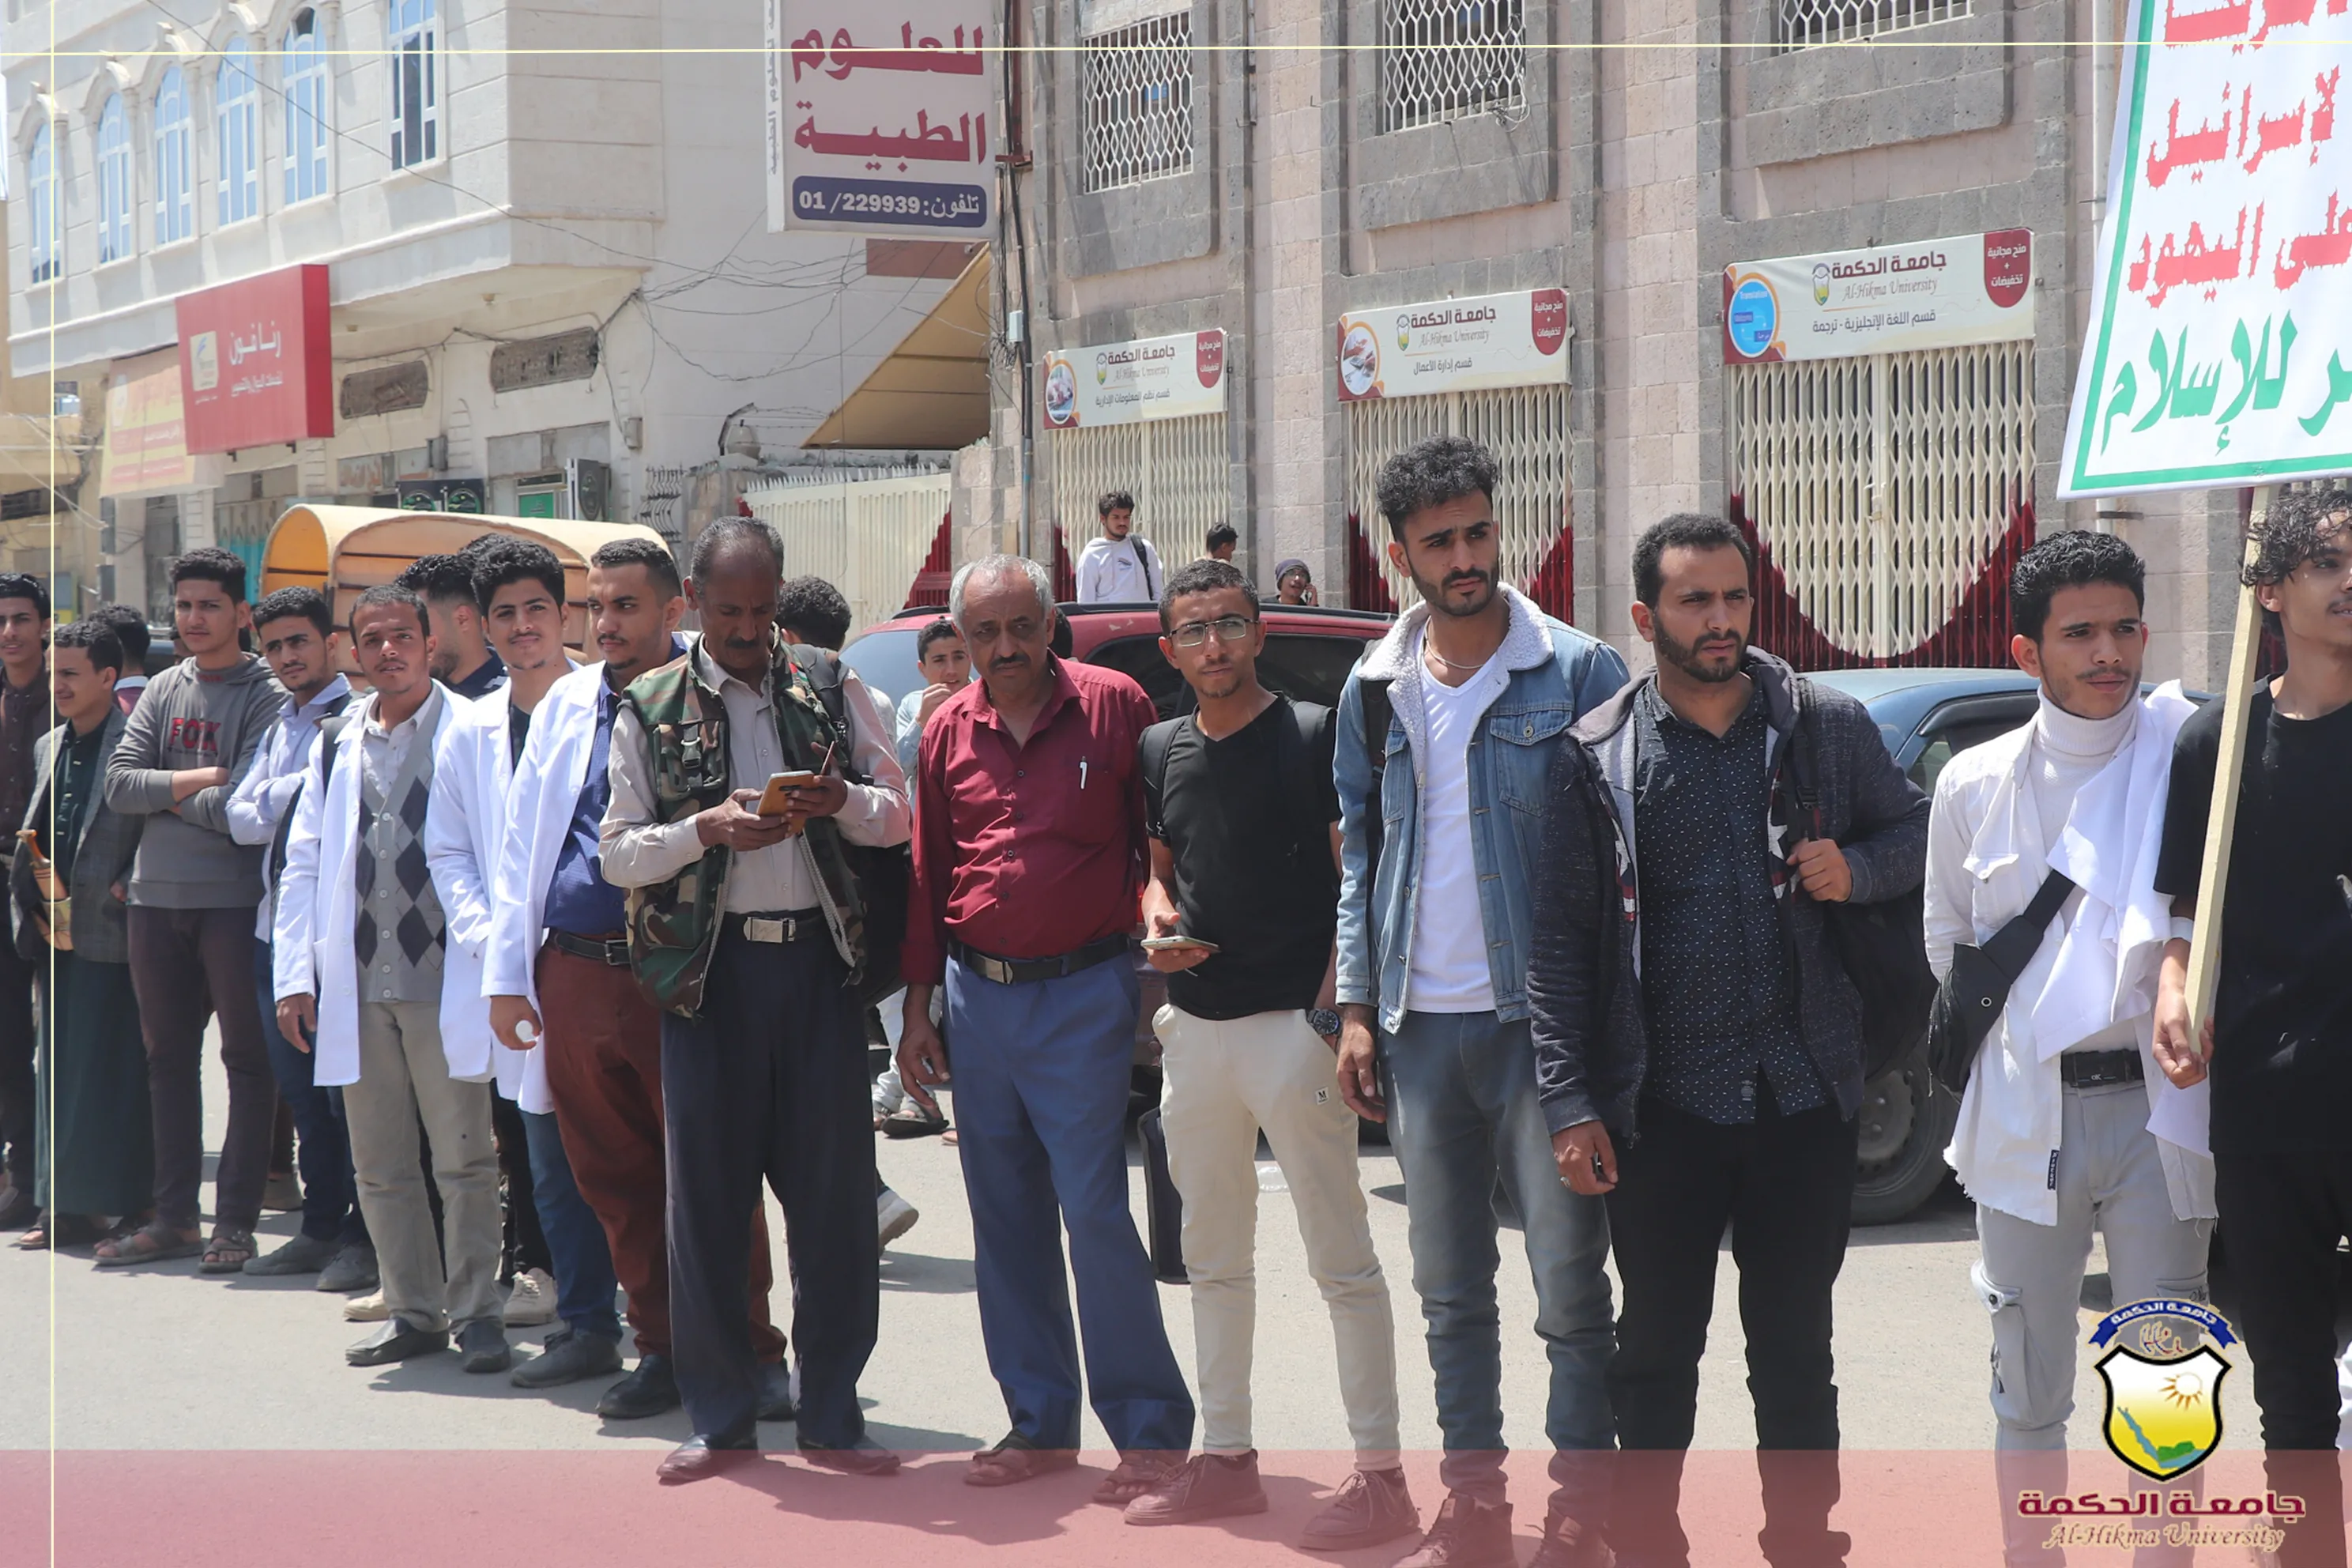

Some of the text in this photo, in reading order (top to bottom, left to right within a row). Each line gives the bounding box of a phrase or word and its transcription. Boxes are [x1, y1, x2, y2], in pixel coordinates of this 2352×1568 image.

[791, 21, 984, 84] للعلوم
[794, 100, 986, 173] الطبية
[2128, 196, 2265, 309] اليهود
[1832, 251, 1947, 280] جامعة الحكمة
[1842, 277, 1939, 302] Al-Hikma University
[1991, 273, 2024, 288] تخفيضات
[1411, 306, 1496, 329] جامعة الحكمة
[1812, 319, 1838, 335] ترجمة
[1886, 311, 1909, 326] اللغة
[1912, 309, 1936, 326] قسم
[1453, 328, 1490, 345] University
[1108, 345, 1176, 365] جامعة الحكمة
[1454, 357, 1472, 372] قسم
[2100, 308, 2298, 457] للإسلام
